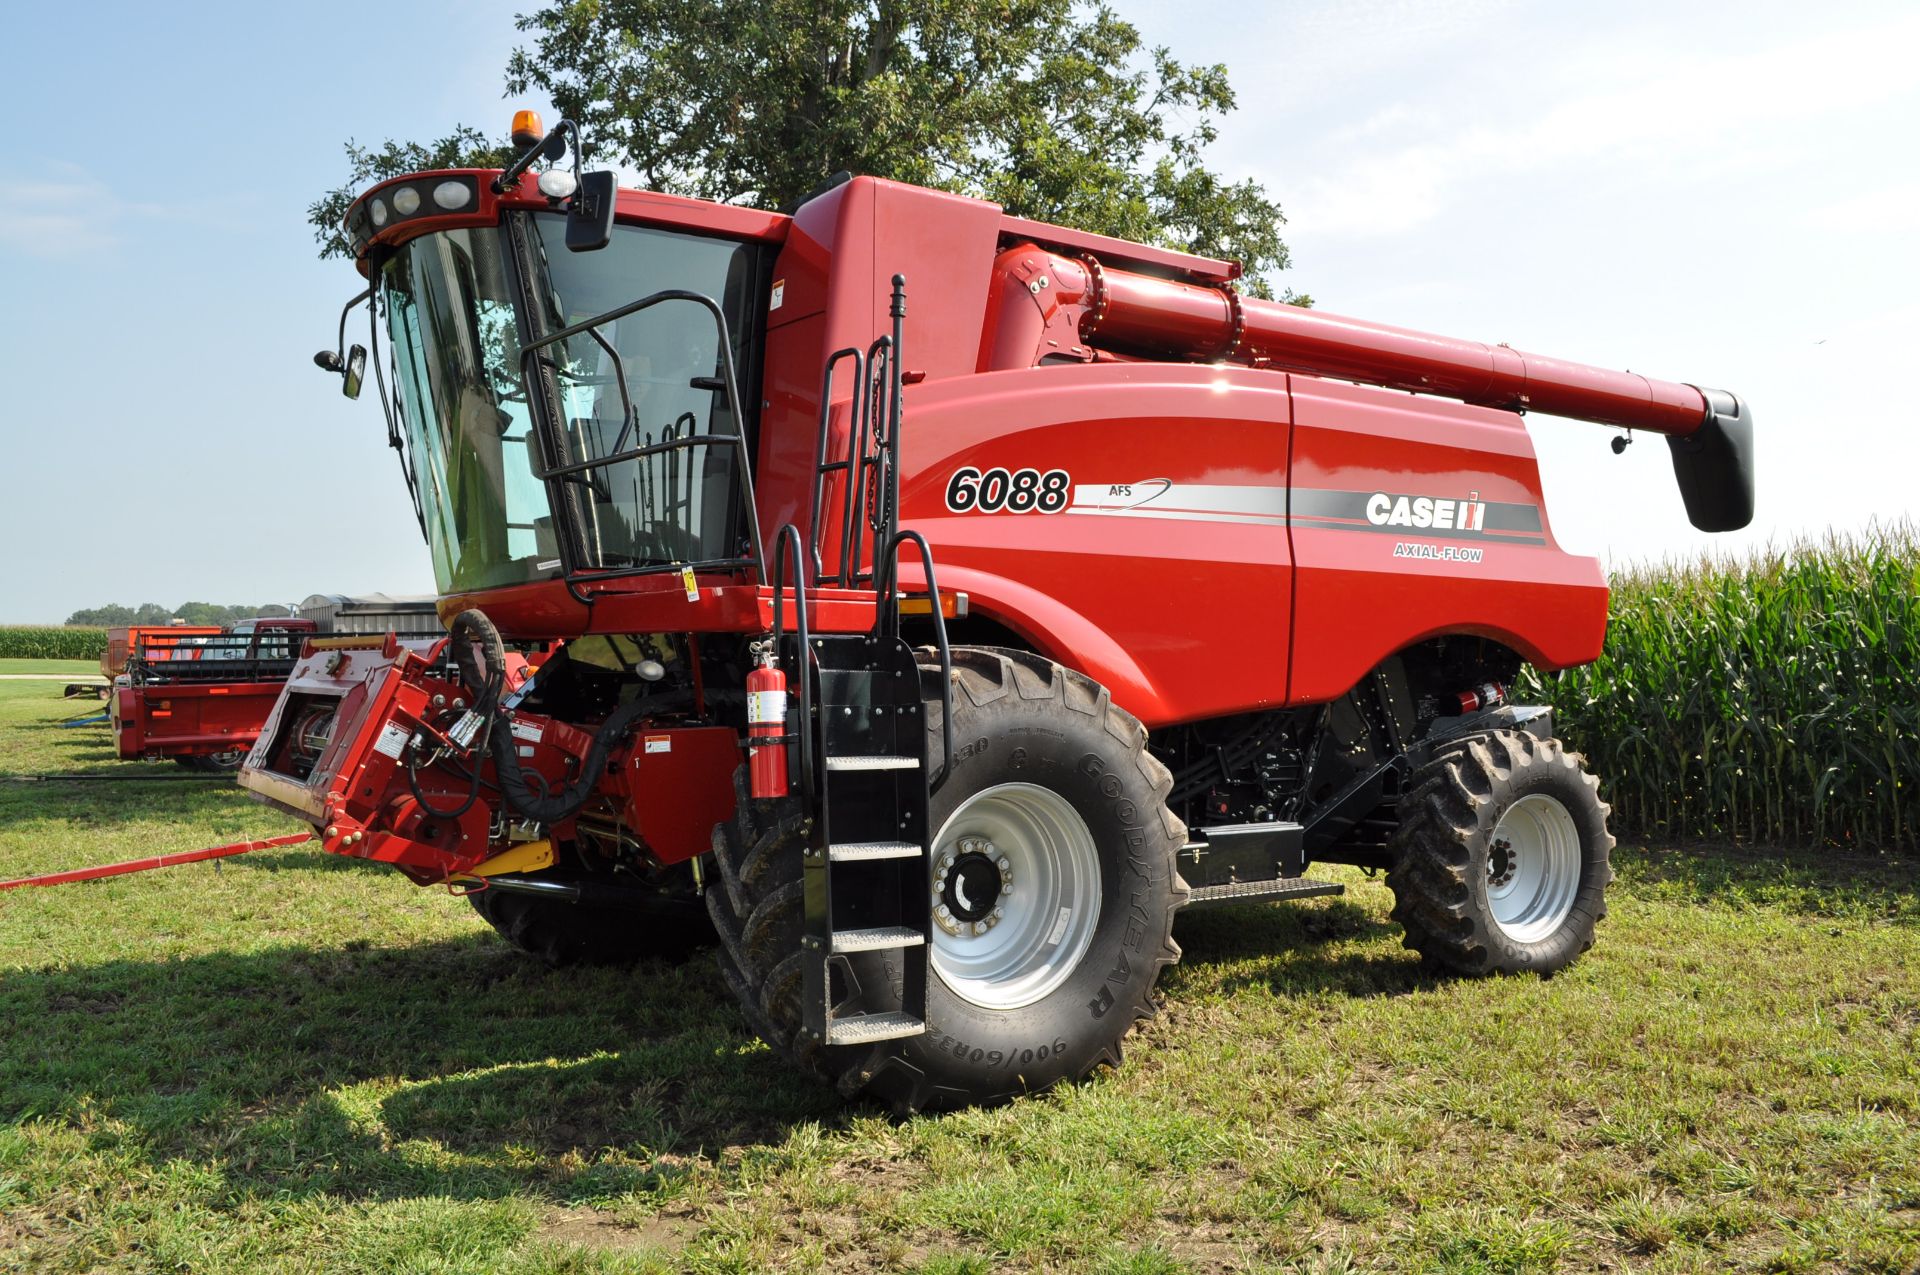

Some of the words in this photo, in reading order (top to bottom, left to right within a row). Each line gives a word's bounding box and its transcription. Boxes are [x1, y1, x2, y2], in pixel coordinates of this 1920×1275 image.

[946, 467, 1070, 514] 6088
[1109, 485, 1132, 497] AFS
[1366, 493, 1456, 528] CASE
[1393, 543, 1482, 562] AXIAL-FLOW
[1078, 752, 1153, 1020] GOODYEAR
